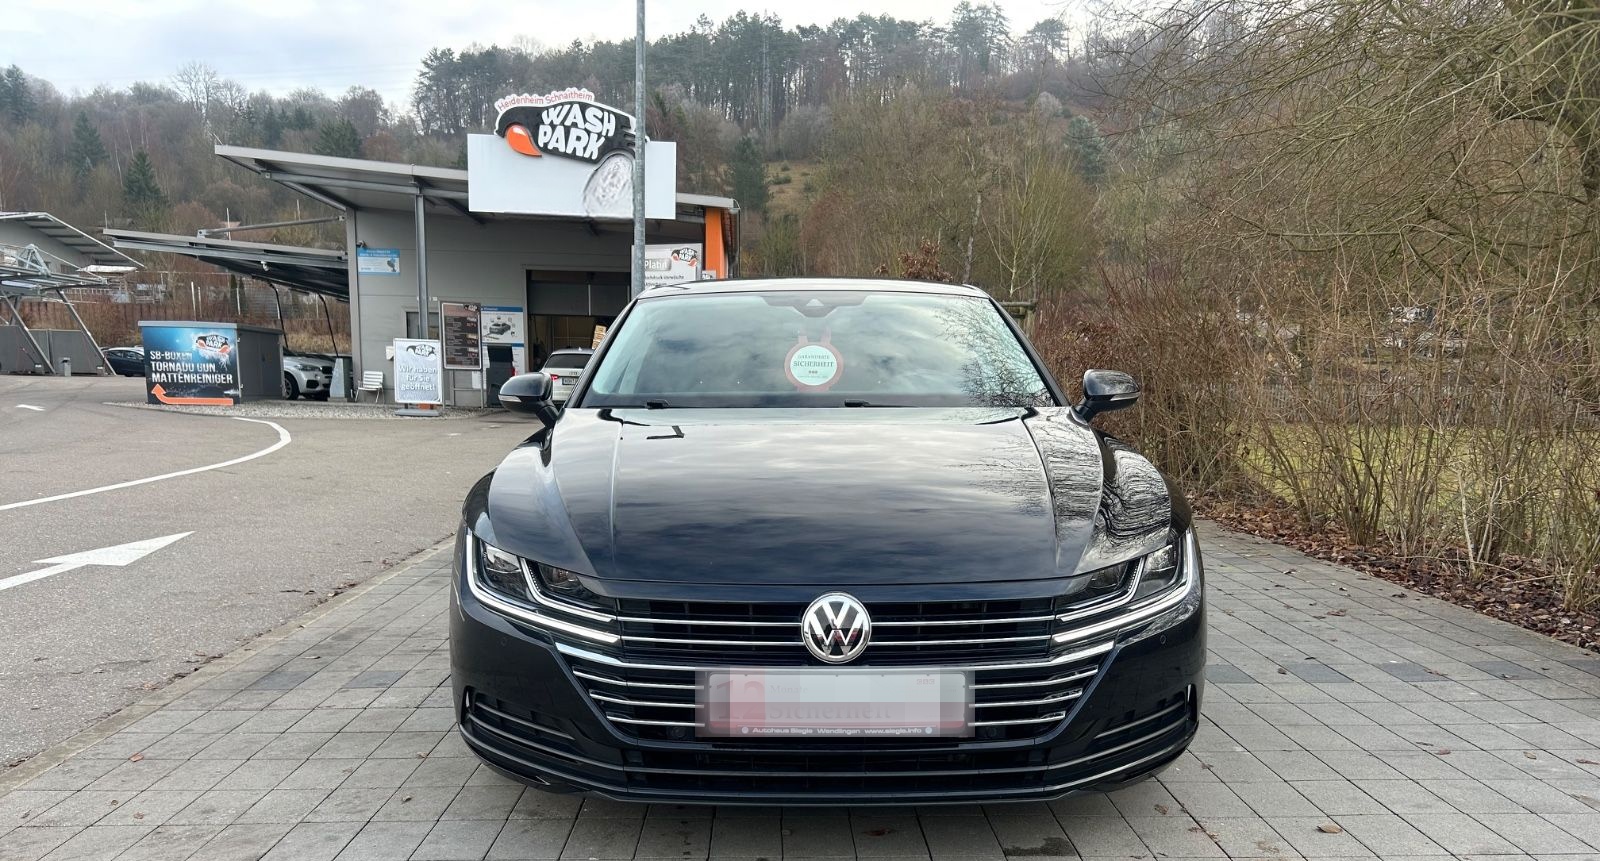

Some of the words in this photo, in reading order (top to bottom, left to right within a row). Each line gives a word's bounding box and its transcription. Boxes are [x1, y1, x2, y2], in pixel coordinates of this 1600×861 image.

[498, 96, 544, 111] Heidenheim
[545, 90, 593, 103] Schnaitheim
[541, 103, 616, 137] WASH
[538, 124, 605, 160] PARK
[150, 351, 192, 360] SB-BOXEN
[151, 362, 194, 372] TORNADO
[399, 365, 413, 373] Wir
[414, 365, 437, 374] haben
[151, 372, 233, 384] MATTENREINIGER
[406, 373, 418, 382] für
[418, 374, 431, 383] Sie
[400, 382, 437, 392] geöffnet!
